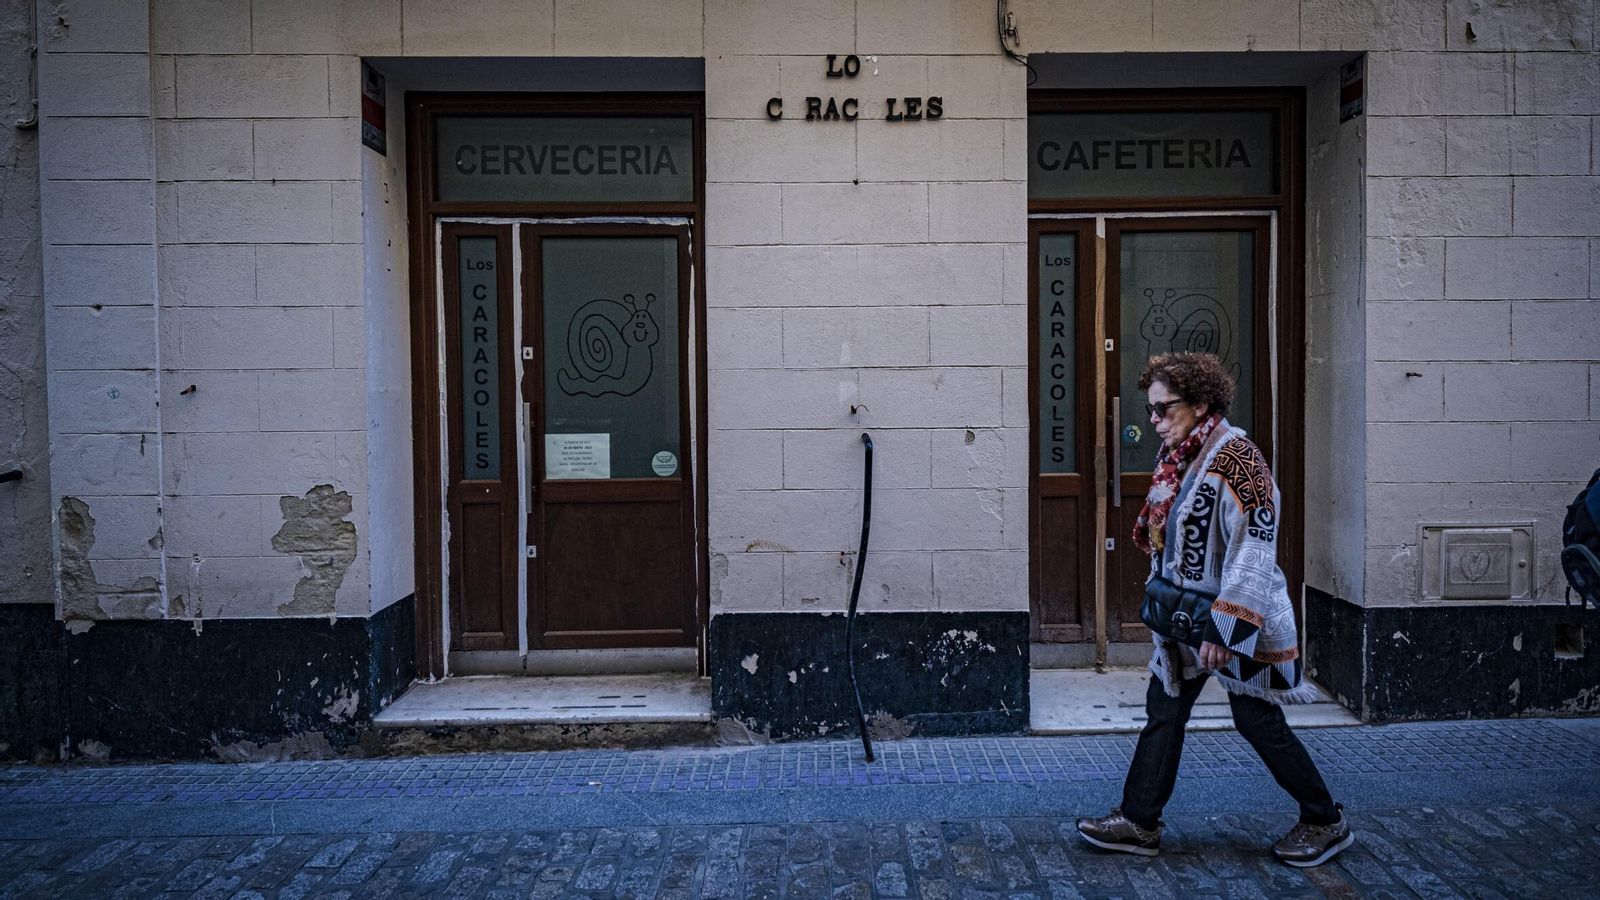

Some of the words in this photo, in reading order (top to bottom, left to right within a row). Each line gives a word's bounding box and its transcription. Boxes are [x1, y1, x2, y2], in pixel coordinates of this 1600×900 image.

[455, 144, 678, 176] CERVECERIA
[1036, 138, 1252, 171] CAFETERIA
[466, 258, 494, 271] Los
[1045, 255, 1071, 267] Los
[472, 283, 490, 470] CARACOLES
[1050, 279, 1066, 463] CARACOLES
